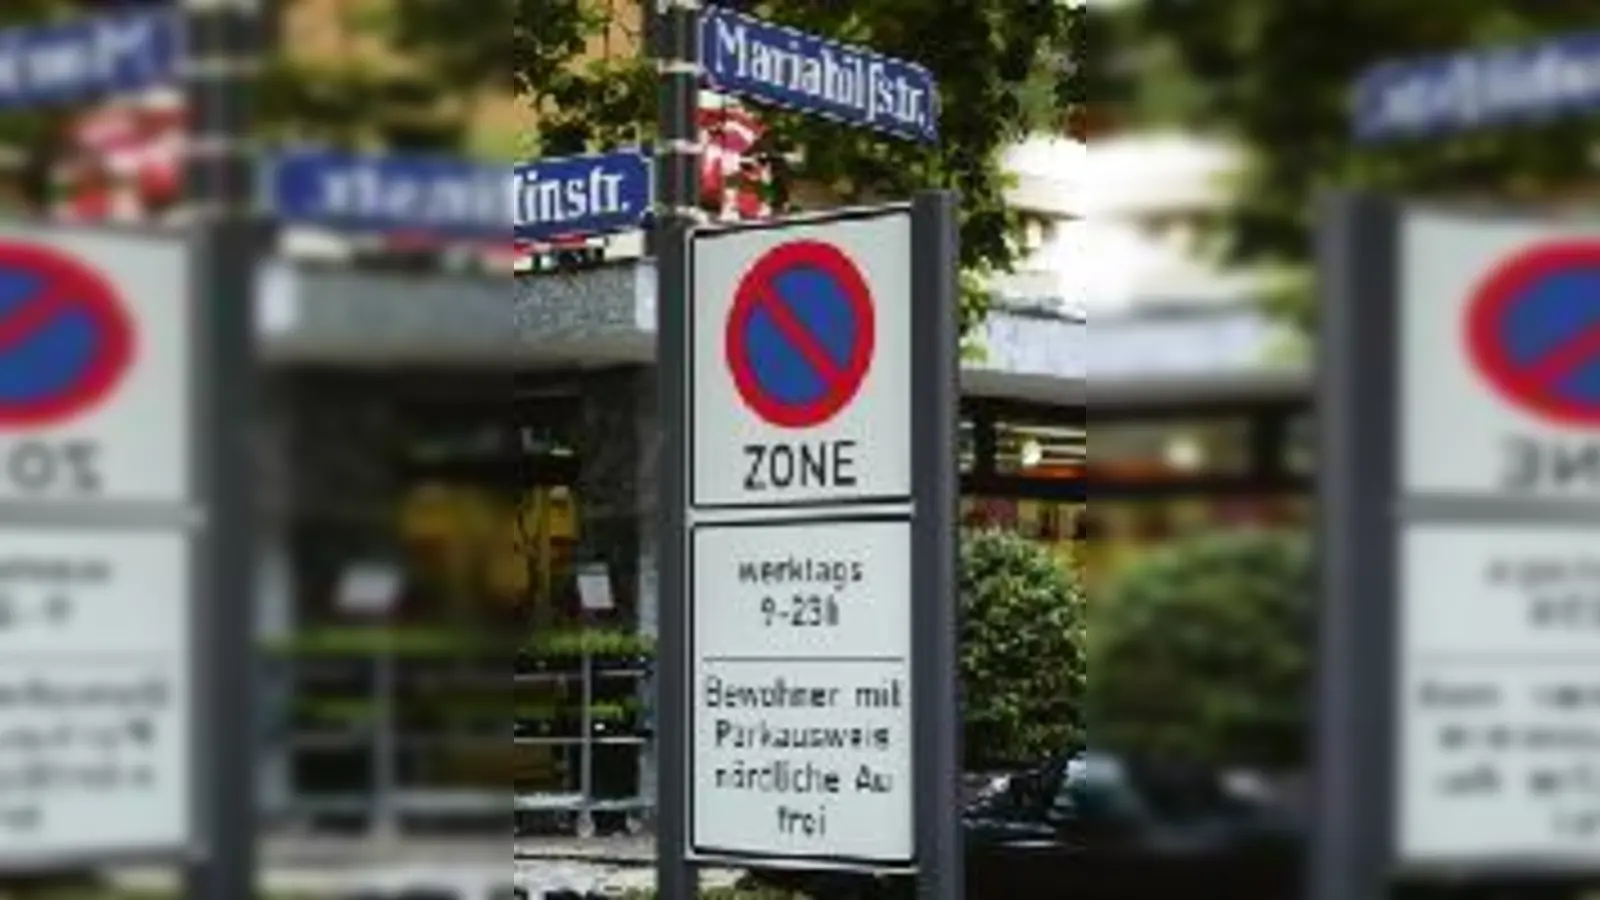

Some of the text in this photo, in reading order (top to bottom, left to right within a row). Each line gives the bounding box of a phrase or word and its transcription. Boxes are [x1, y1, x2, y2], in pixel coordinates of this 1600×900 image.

[714, 17, 926, 127] Mariahilfstr.
[743, 440, 857, 491] ZONE
[738, 555, 863, 591] werktags
[705, 675, 902, 708] Bewohner mit
[715, 719, 889, 750] Parkausweis
[715, 759, 893, 793] nördliche Au
[777, 805, 826, 837] frei
